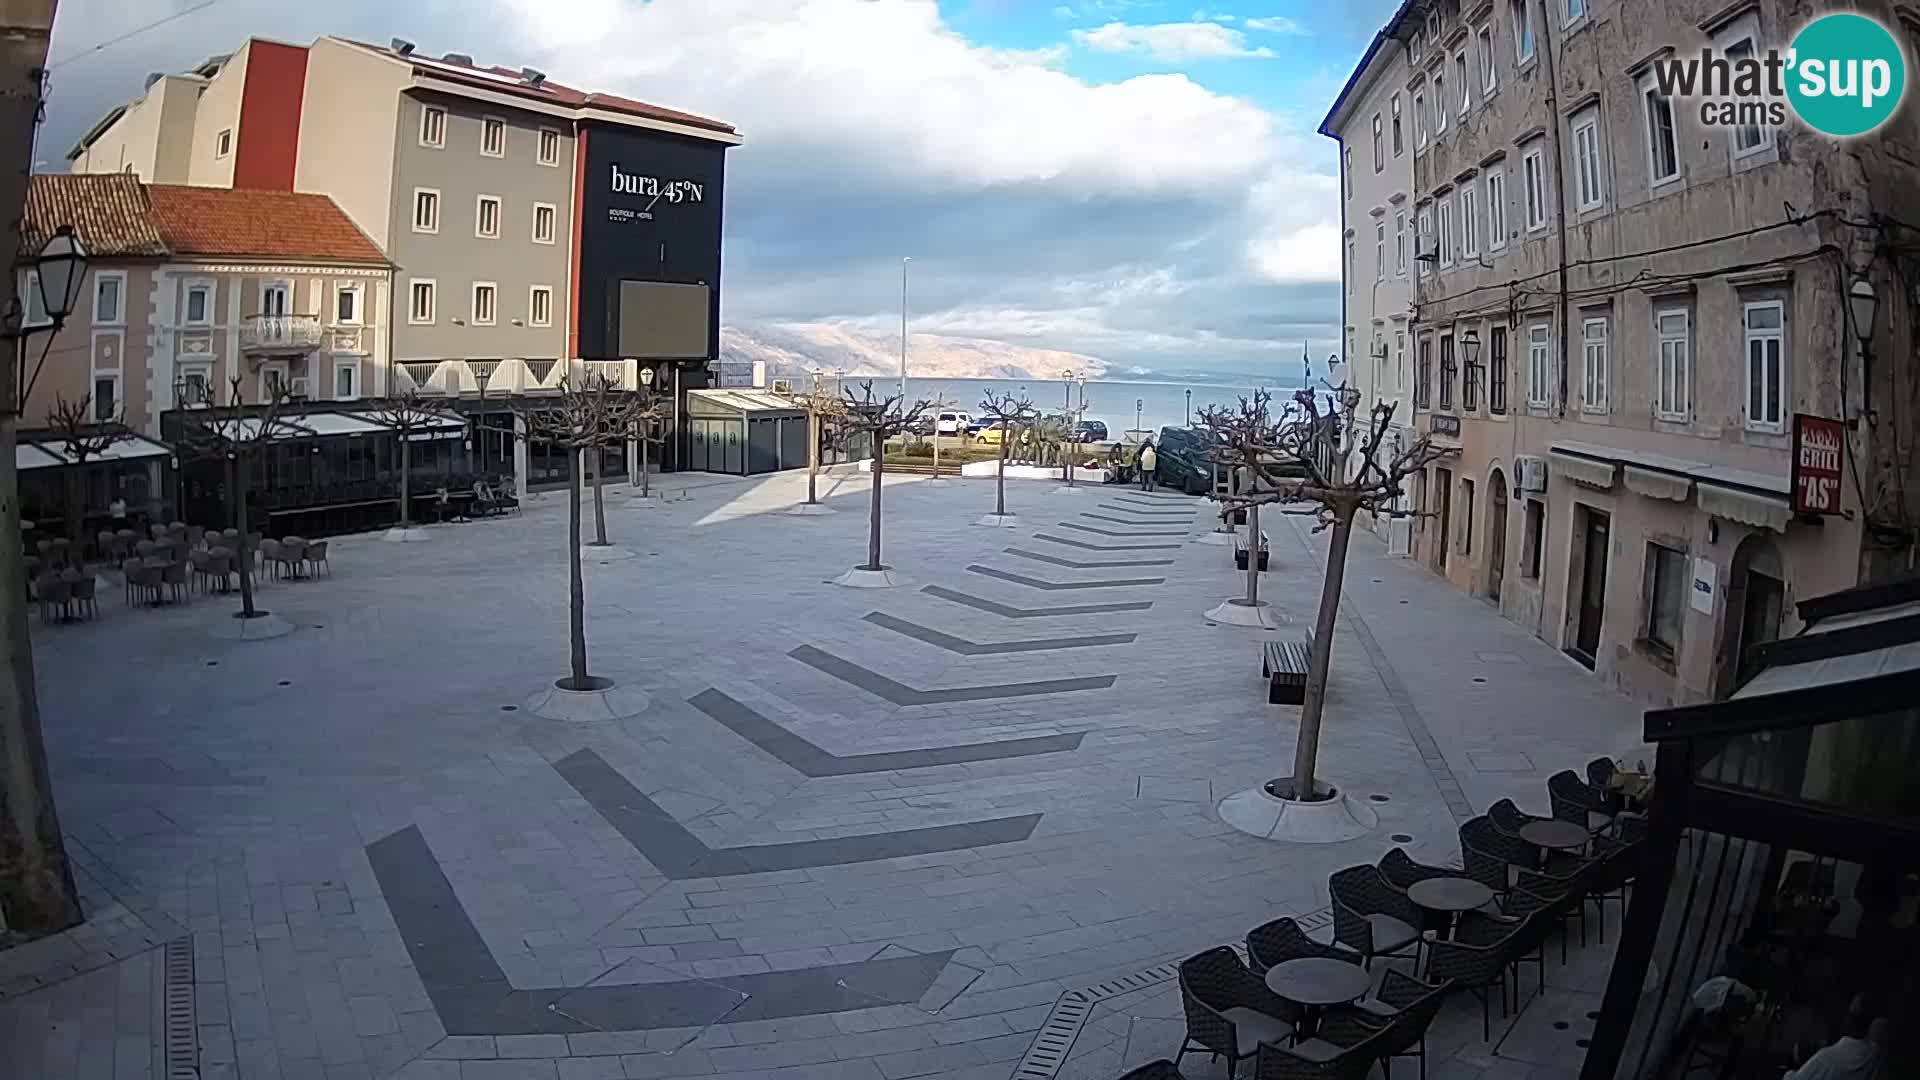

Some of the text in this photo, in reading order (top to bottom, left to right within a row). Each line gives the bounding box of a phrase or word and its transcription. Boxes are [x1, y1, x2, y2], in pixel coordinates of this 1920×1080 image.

[612, 165, 658, 196] bura
[636, 211, 653, 220] HOTEL
[1800, 447, 1840, 471] GRILL
